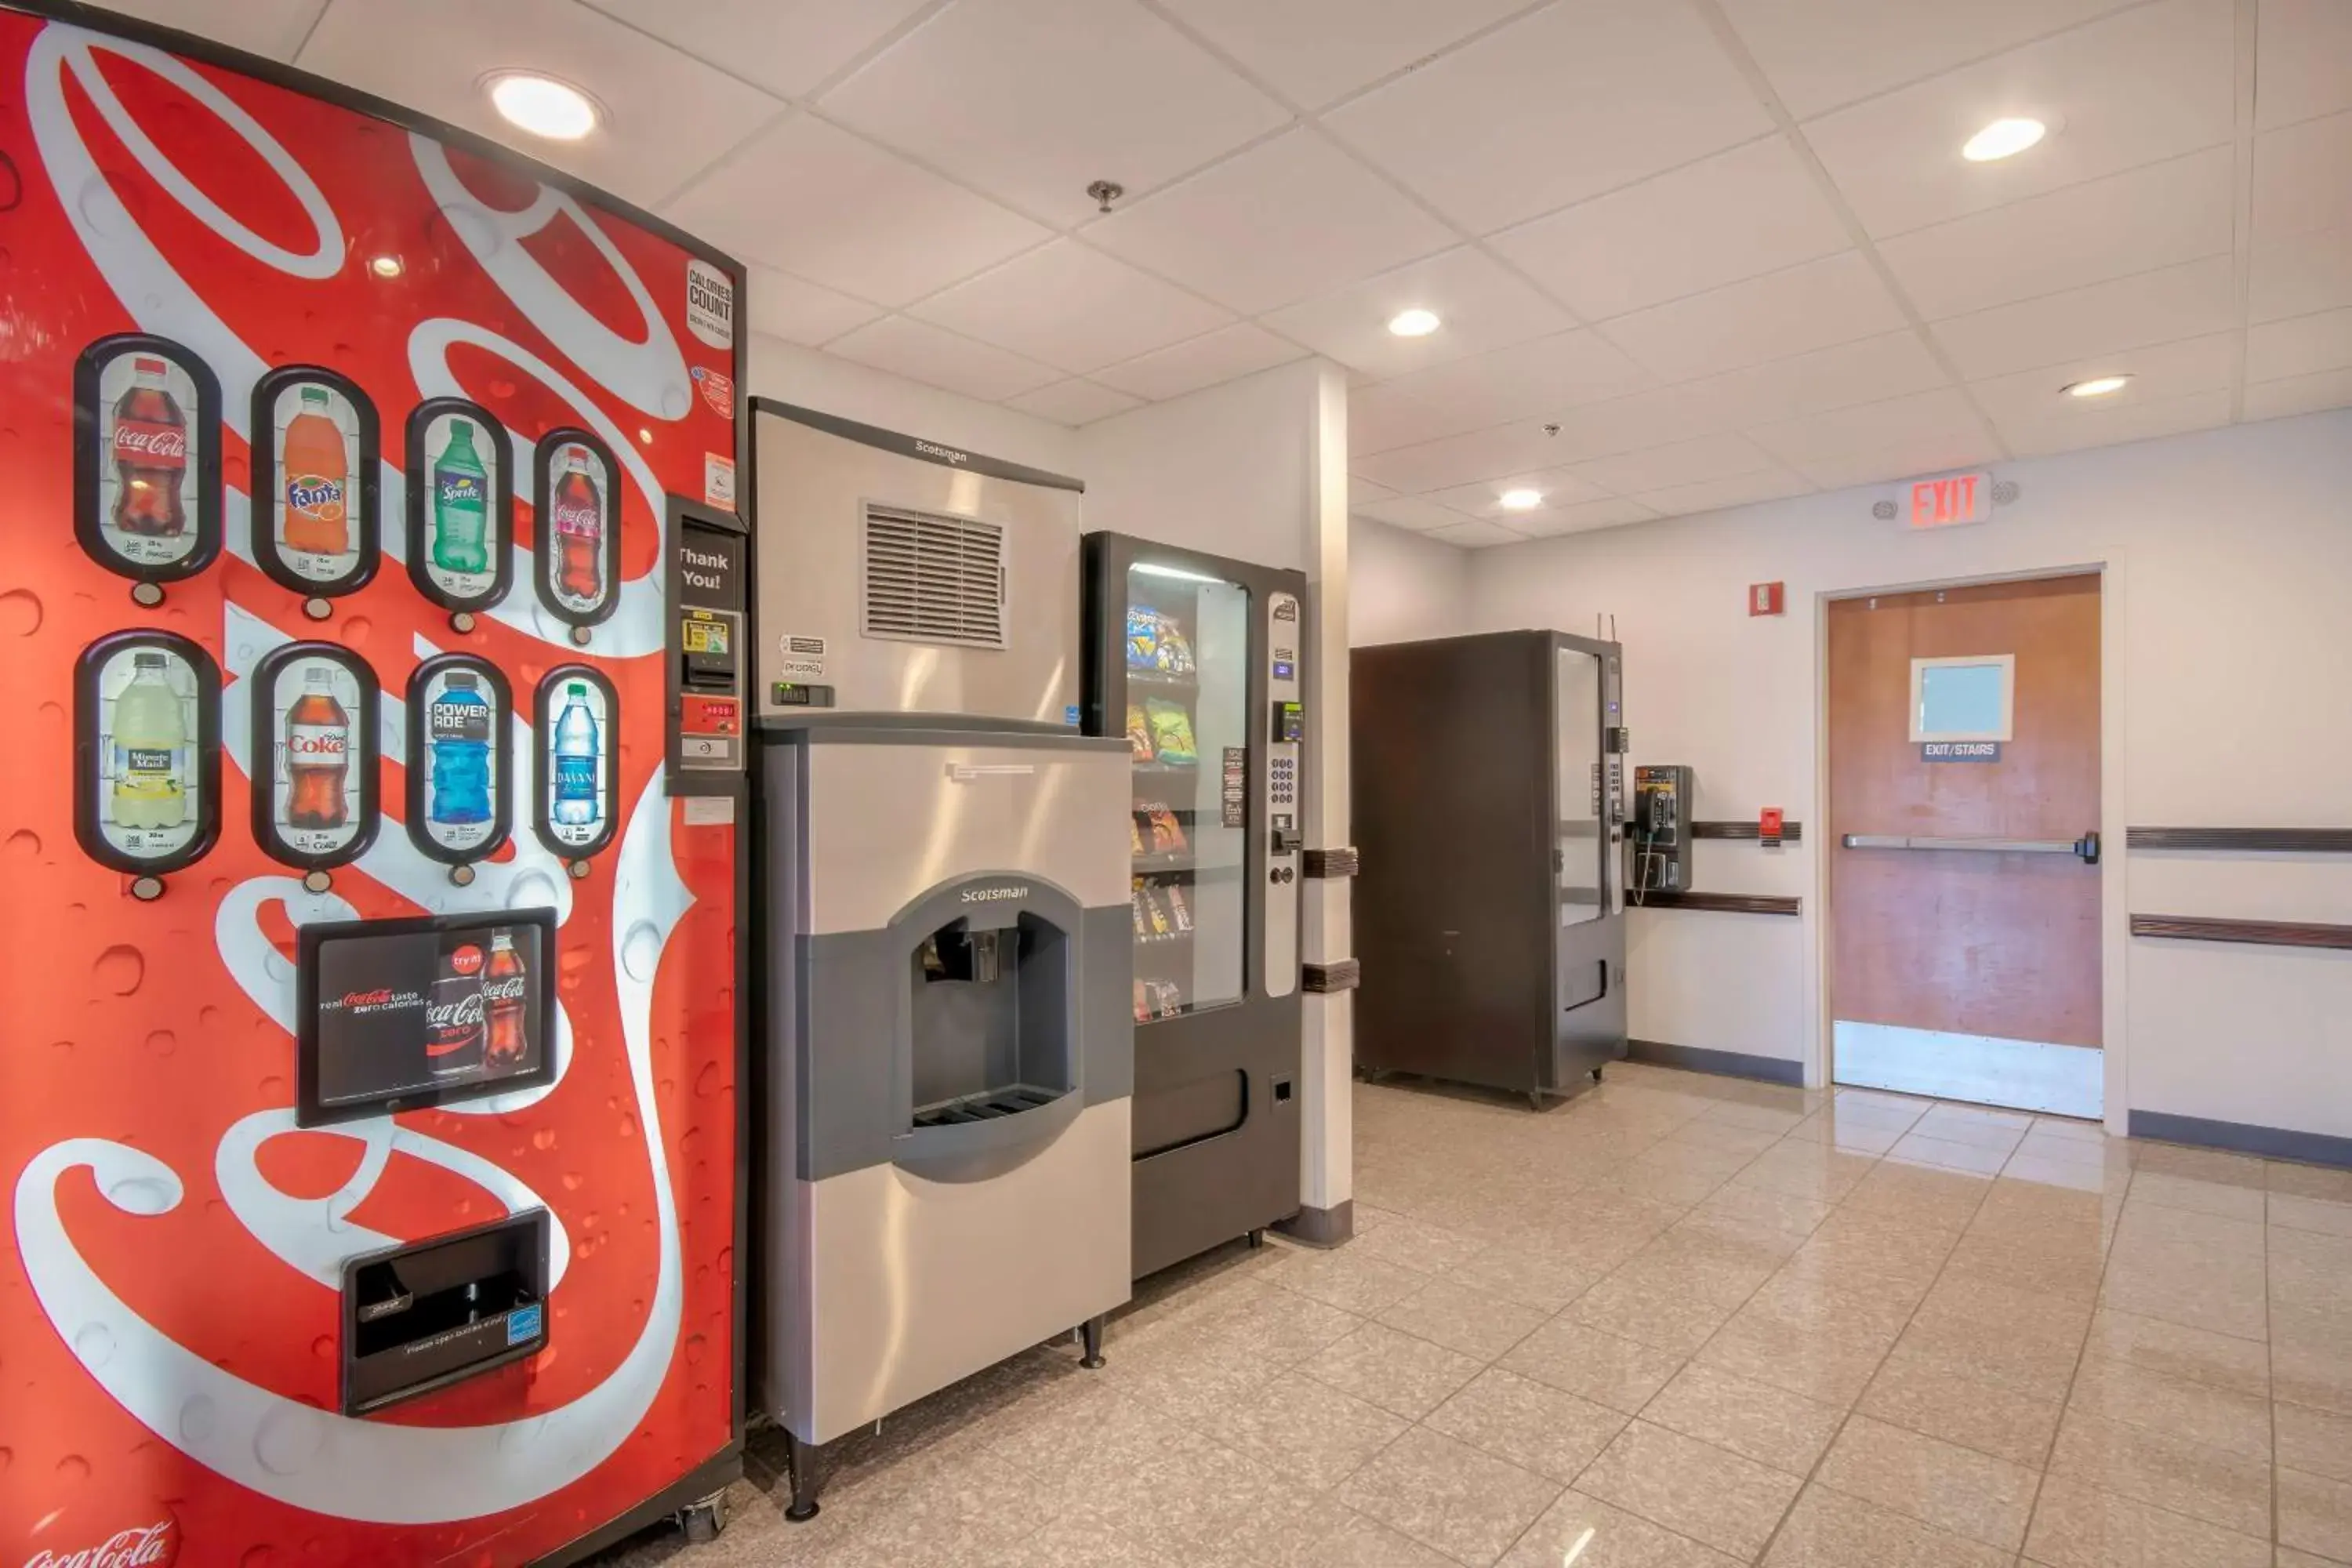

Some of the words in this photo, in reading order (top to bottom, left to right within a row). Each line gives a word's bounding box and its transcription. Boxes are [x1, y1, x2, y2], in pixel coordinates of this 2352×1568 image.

[689, 269, 731, 301] CALORIES
[690, 285, 731, 321] COUNT
[114, 425, 186, 459] Coca-Cola
[916, 440, 967, 462] Scotsman
[443, 485, 478, 501] Sprite
[1911, 475, 1980, 526] EXIT
[680, 548, 728, 570] Thank
[682, 569, 720, 590] You!
[434, 703, 488, 717] POWER
[289, 735, 345, 753] Coke
[1925, 743, 1995, 756] EXIT/STAIRS
[132, 751, 169, 761] Minute
[960, 887, 1029, 902] Scotsman
[454, 957, 470, 967] try
[320, 998, 343, 1010] real
[390, 990, 418, 1001] taste
[354, 1004, 380, 1014] zero
[382, 998, 424, 1010] calories
[440, 1025, 471, 1038] zero
